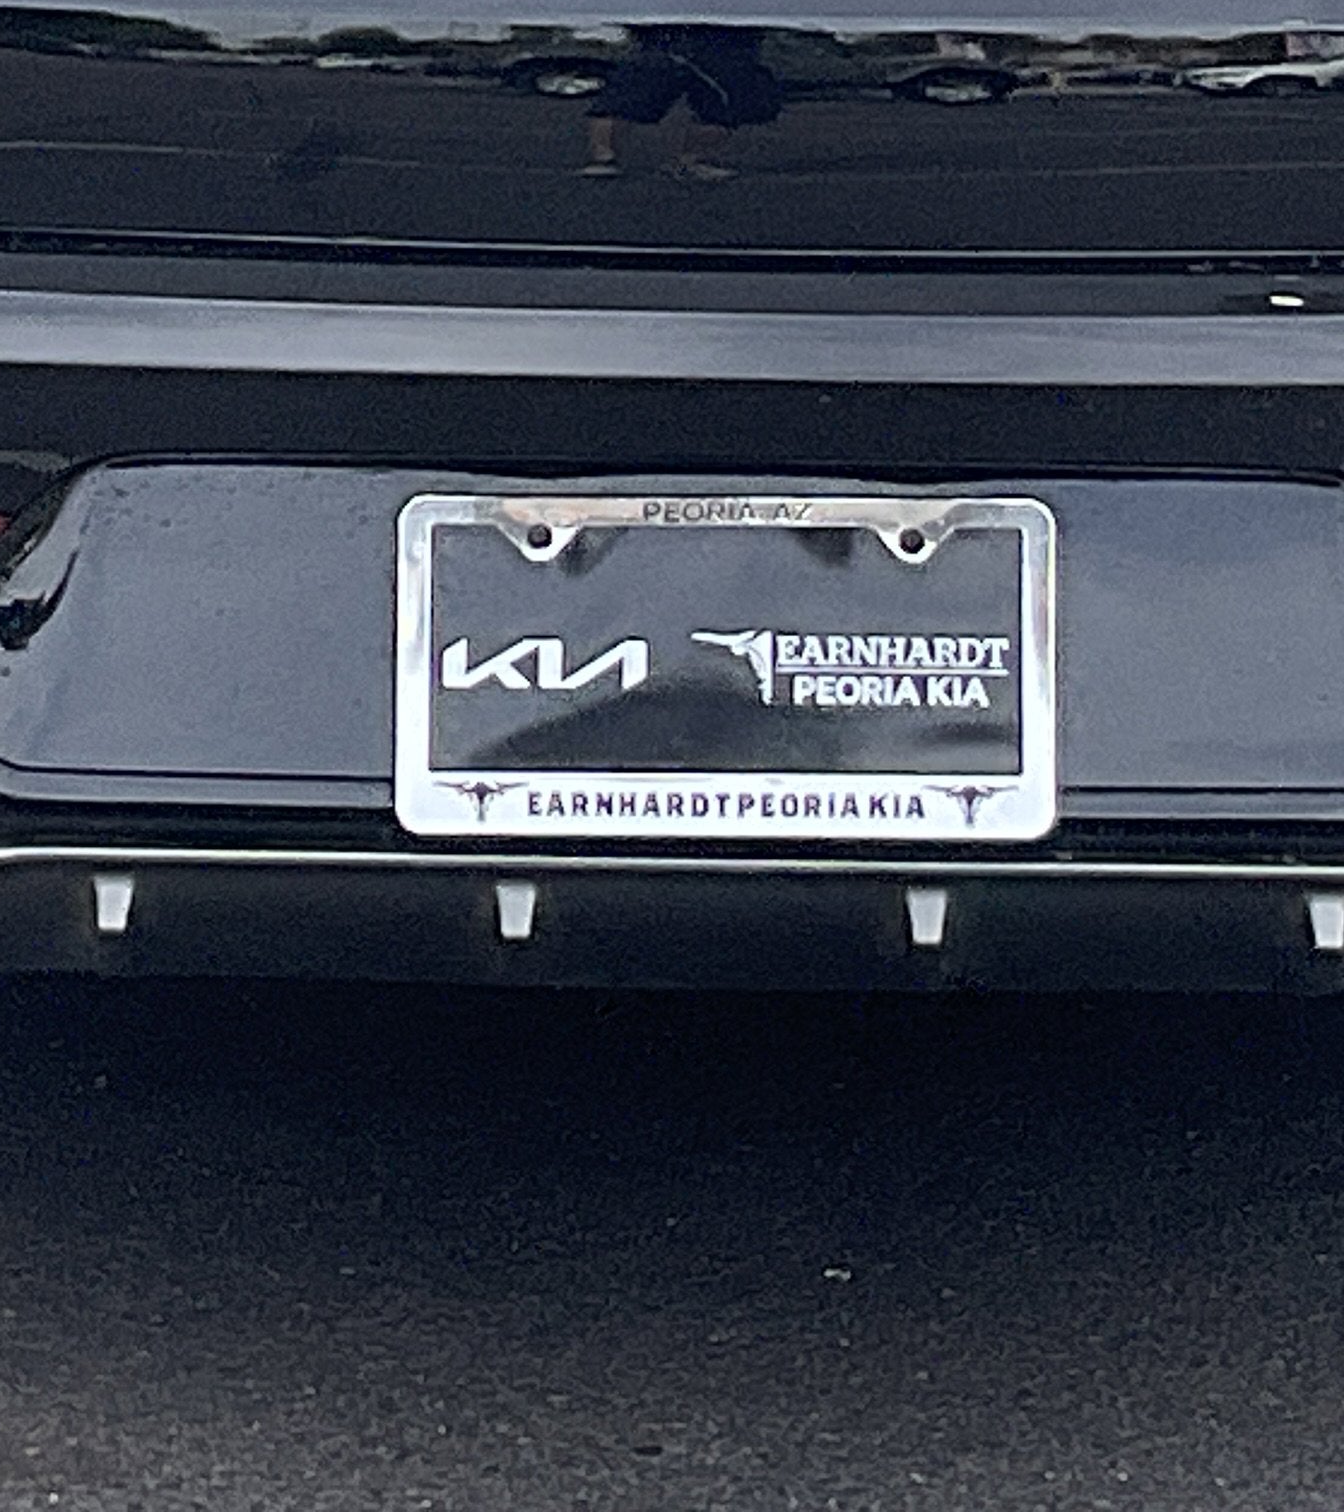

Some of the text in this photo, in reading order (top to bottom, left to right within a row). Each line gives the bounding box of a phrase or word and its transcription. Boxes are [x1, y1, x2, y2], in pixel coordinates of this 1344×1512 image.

[442, 637, 649, 689] KIA
[776, 635, 1010, 669] EARNHARDT
[793, 676, 990, 708] PEORIA KIA
